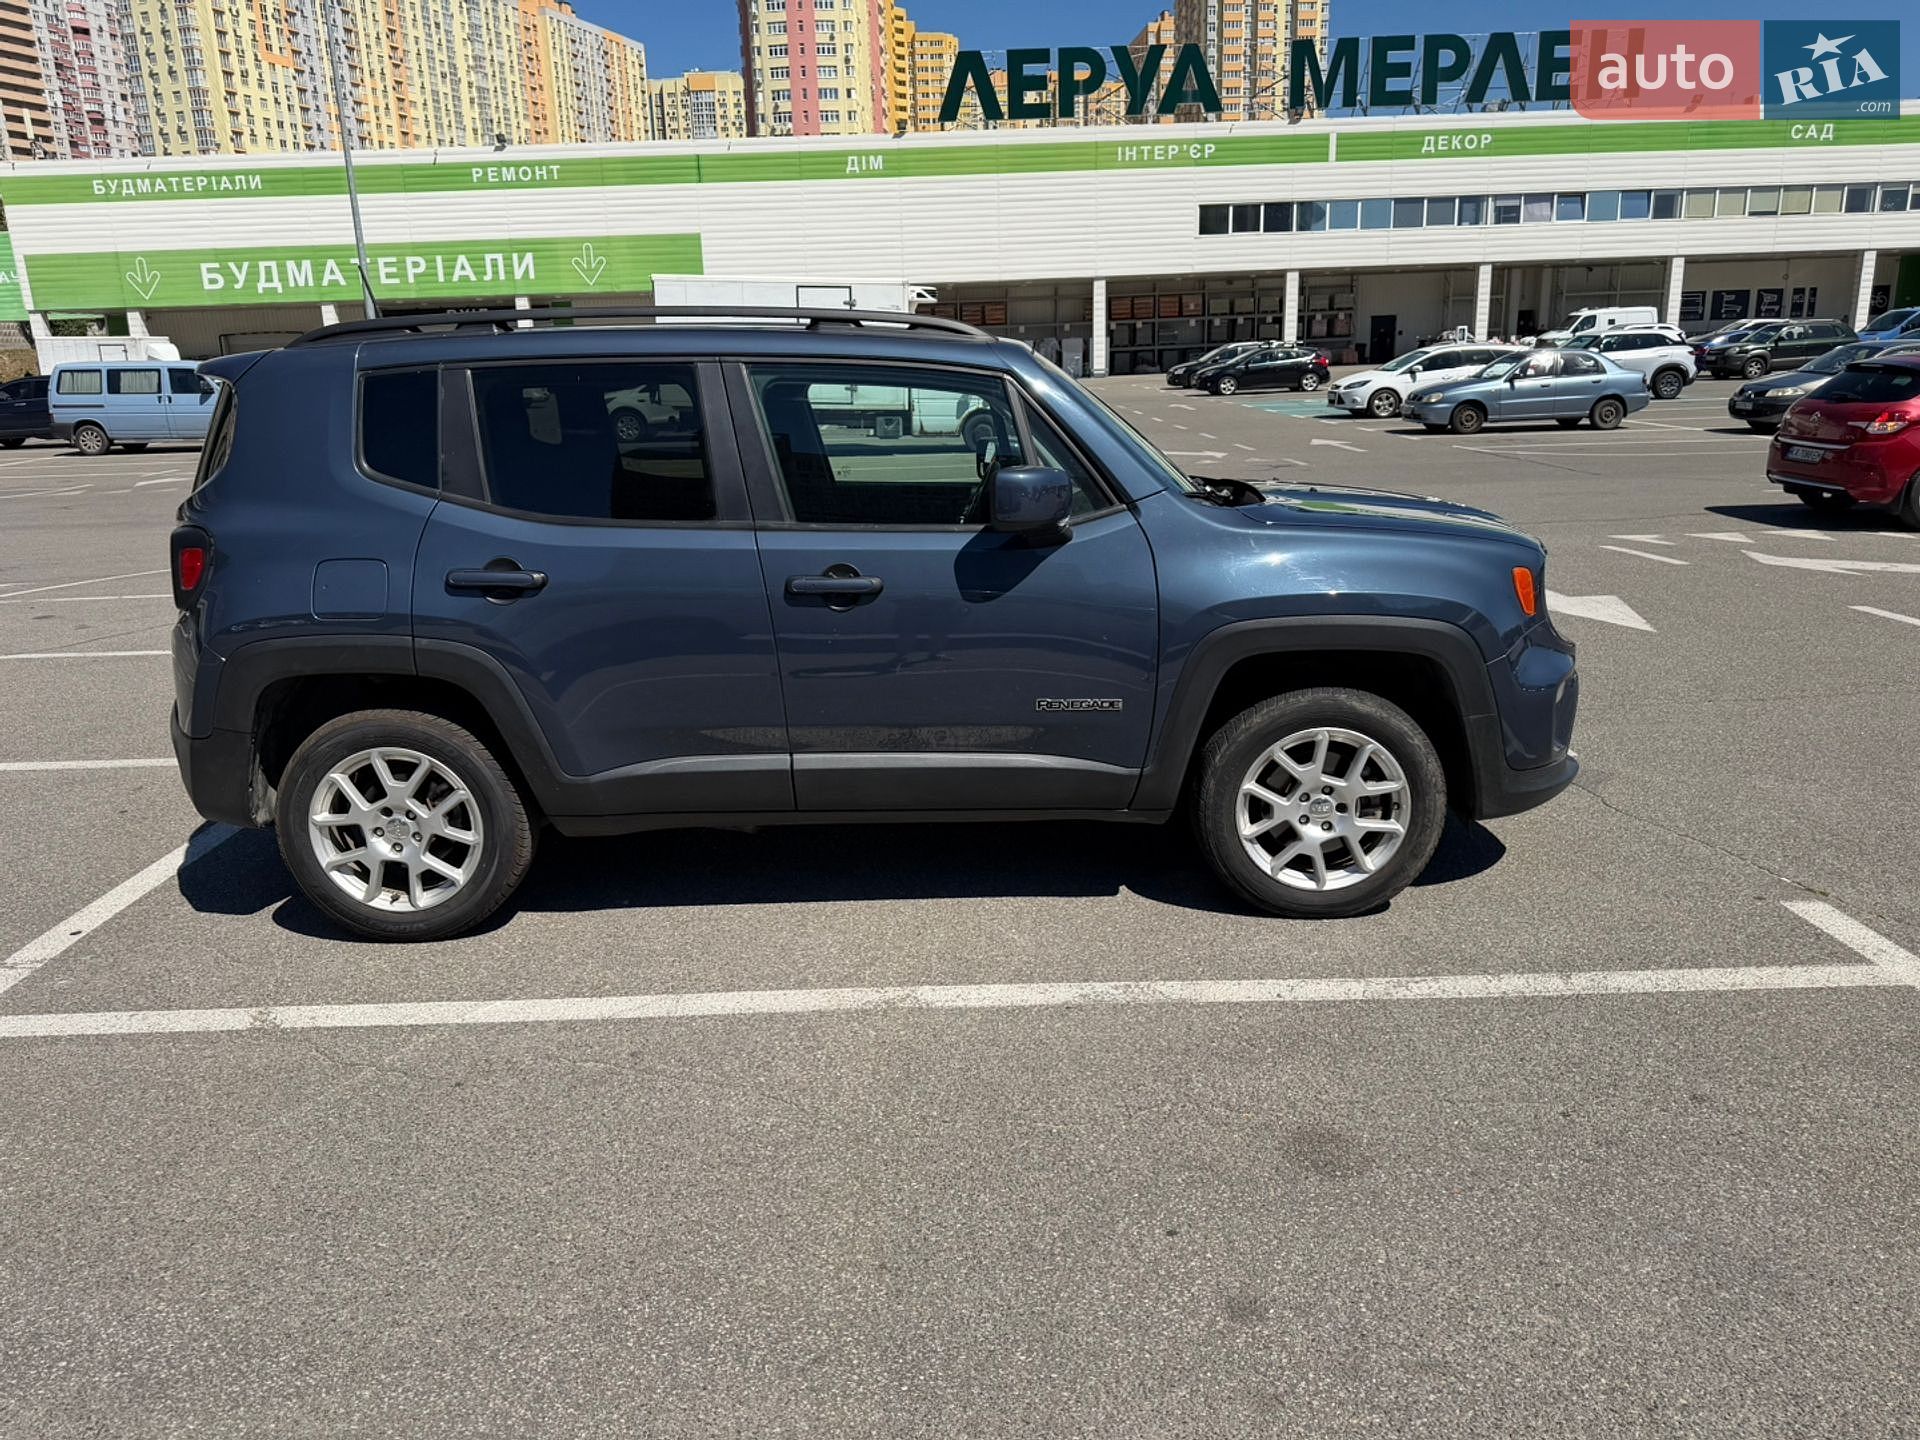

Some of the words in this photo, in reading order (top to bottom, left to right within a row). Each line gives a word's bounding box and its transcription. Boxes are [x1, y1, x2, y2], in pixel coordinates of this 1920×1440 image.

[938, 43, 1223, 122] ЛЕРУА
[1791, 123, 1834, 141] САД
[1117, 143, 1216, 161] ІНТЕР'ЄР
[1421, 134, 1493, 154] ДЕКОР
[471, 165, 560, 183] РЕМОНТ
[846, 155, 883, 174] ДІМ
[92, 175, 262, 196] БУДМАТЕРІАЛИ
[200, 252, 535, 294] БУДМАТЕРІАЛИ
[1036, 698, 1123, 711] RENEGADE
